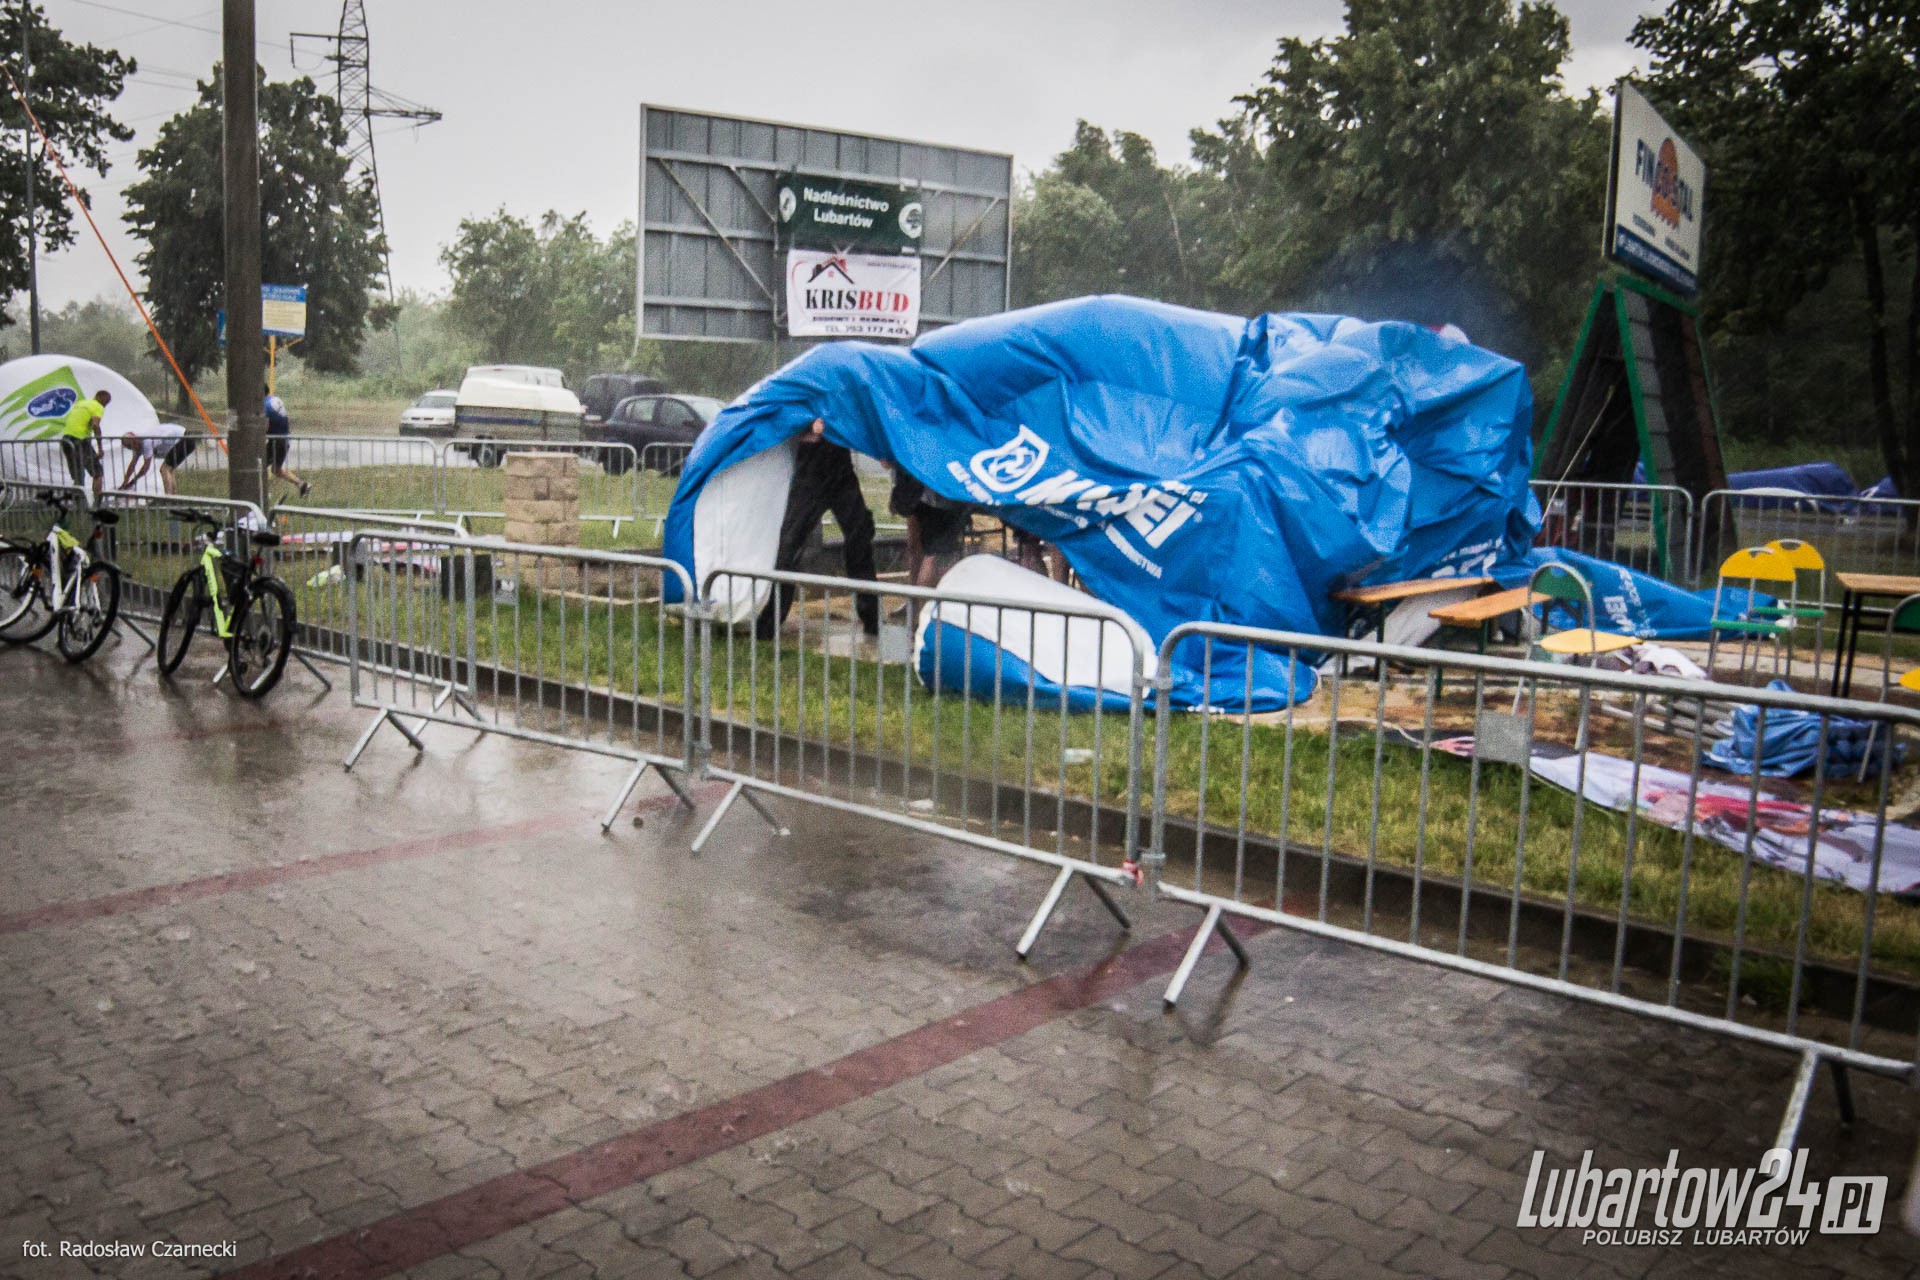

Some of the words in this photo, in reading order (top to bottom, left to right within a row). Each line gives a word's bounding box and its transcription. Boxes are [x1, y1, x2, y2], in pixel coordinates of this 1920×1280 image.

[803, 187, 889, 212] Nadleśnictwo
[813, 207, 874, 228] Lubartów
[806, 289, 910, 312] KRISBUD
